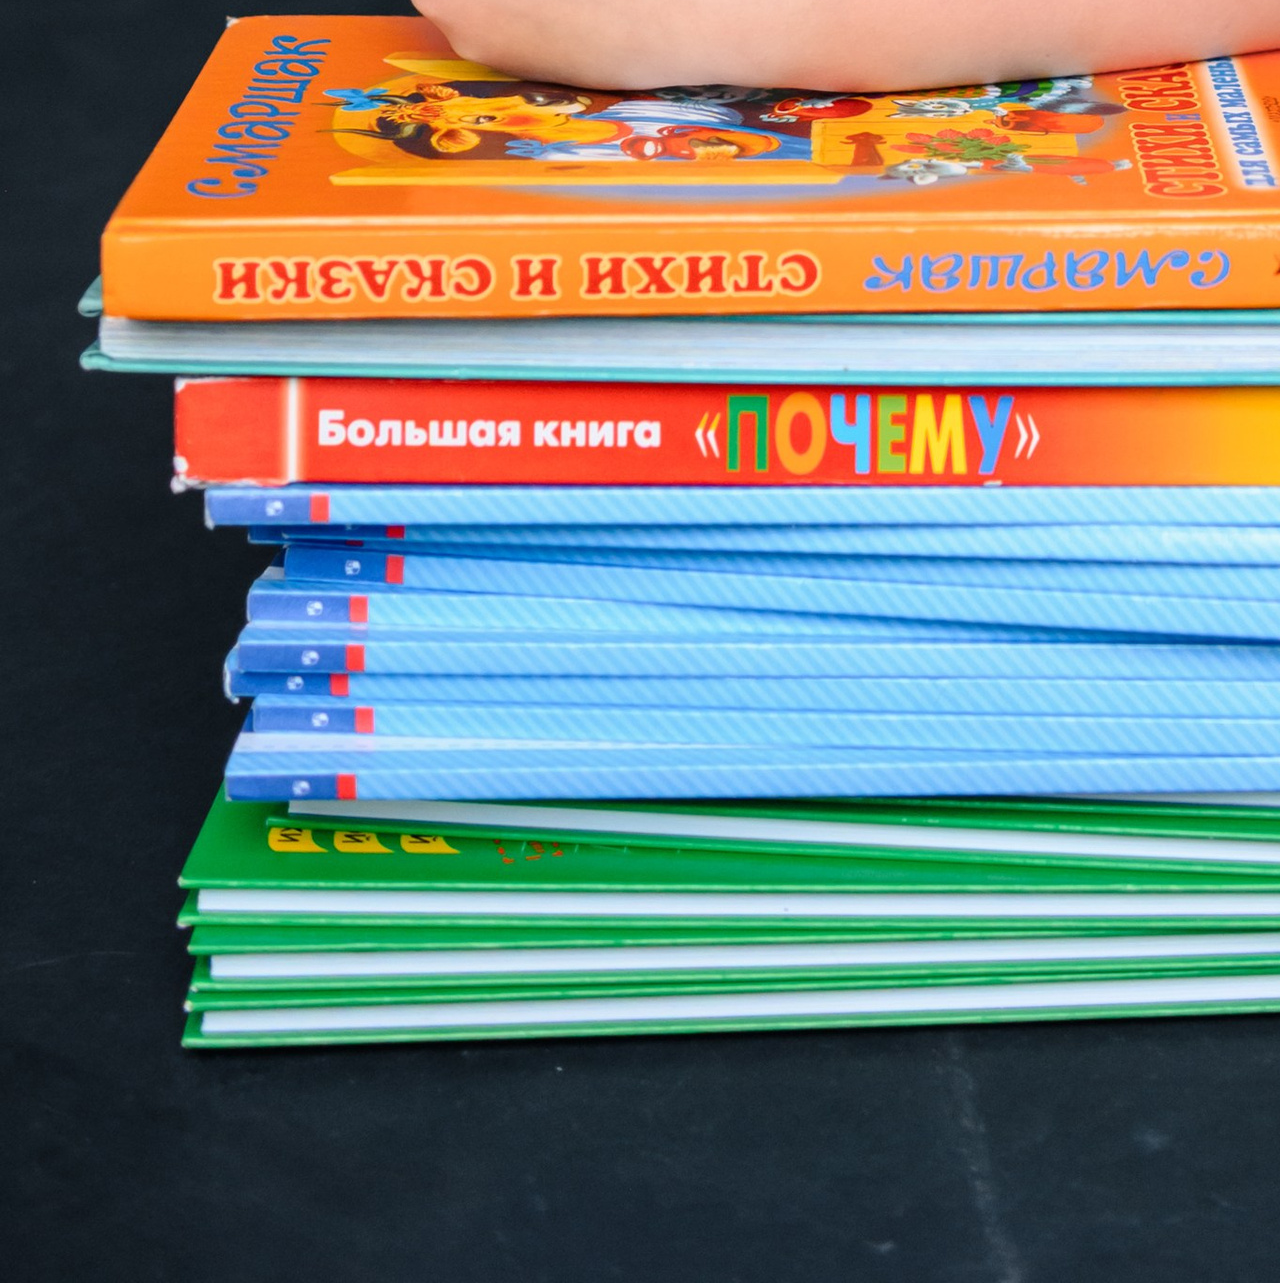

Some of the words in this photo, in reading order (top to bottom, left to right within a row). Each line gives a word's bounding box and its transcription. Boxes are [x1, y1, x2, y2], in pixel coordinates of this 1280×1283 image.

[1223, 111, 1265, 156] самых
[1130, 122, 1227, 198] СТИХИ
[1238, 160, 1277, 187] для
[216, 257, 494, 301] СКАЗКИ
[513, 258, 559, 297] И
[582, 252, 820, 296] СТИХИ
[317, 408, 522, 448] Большая
[533, 420, 662, 448] книга
